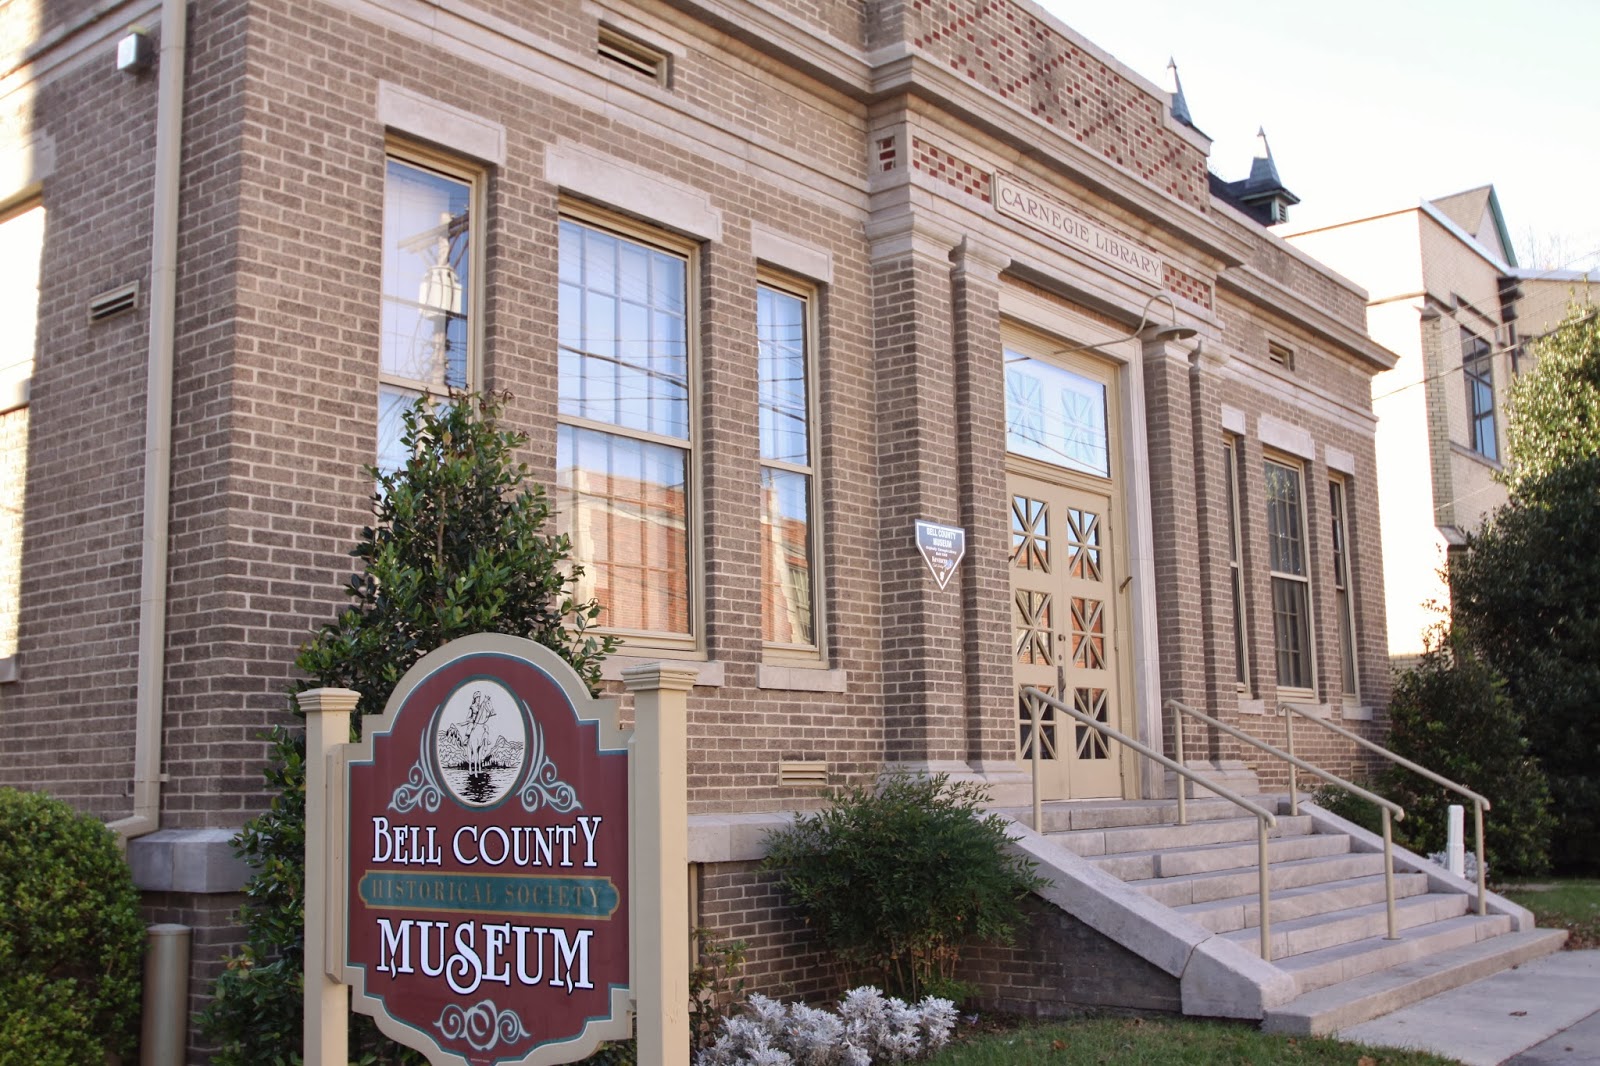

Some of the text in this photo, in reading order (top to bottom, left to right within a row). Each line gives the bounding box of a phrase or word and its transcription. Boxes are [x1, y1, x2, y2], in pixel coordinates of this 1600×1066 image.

[1001, 187, 1160, 278] CARNEGIE LIBRARY
[926, 527, 956, 540] BELL COUNTY
[933, 537, 952, 548] MUSEUM
[372, 815, 602, 867] BELL COUNTY
[372, 877, 602, 909] HISTORICAL SOCIETY
[375, 918, 595, 995] MUSEUM
